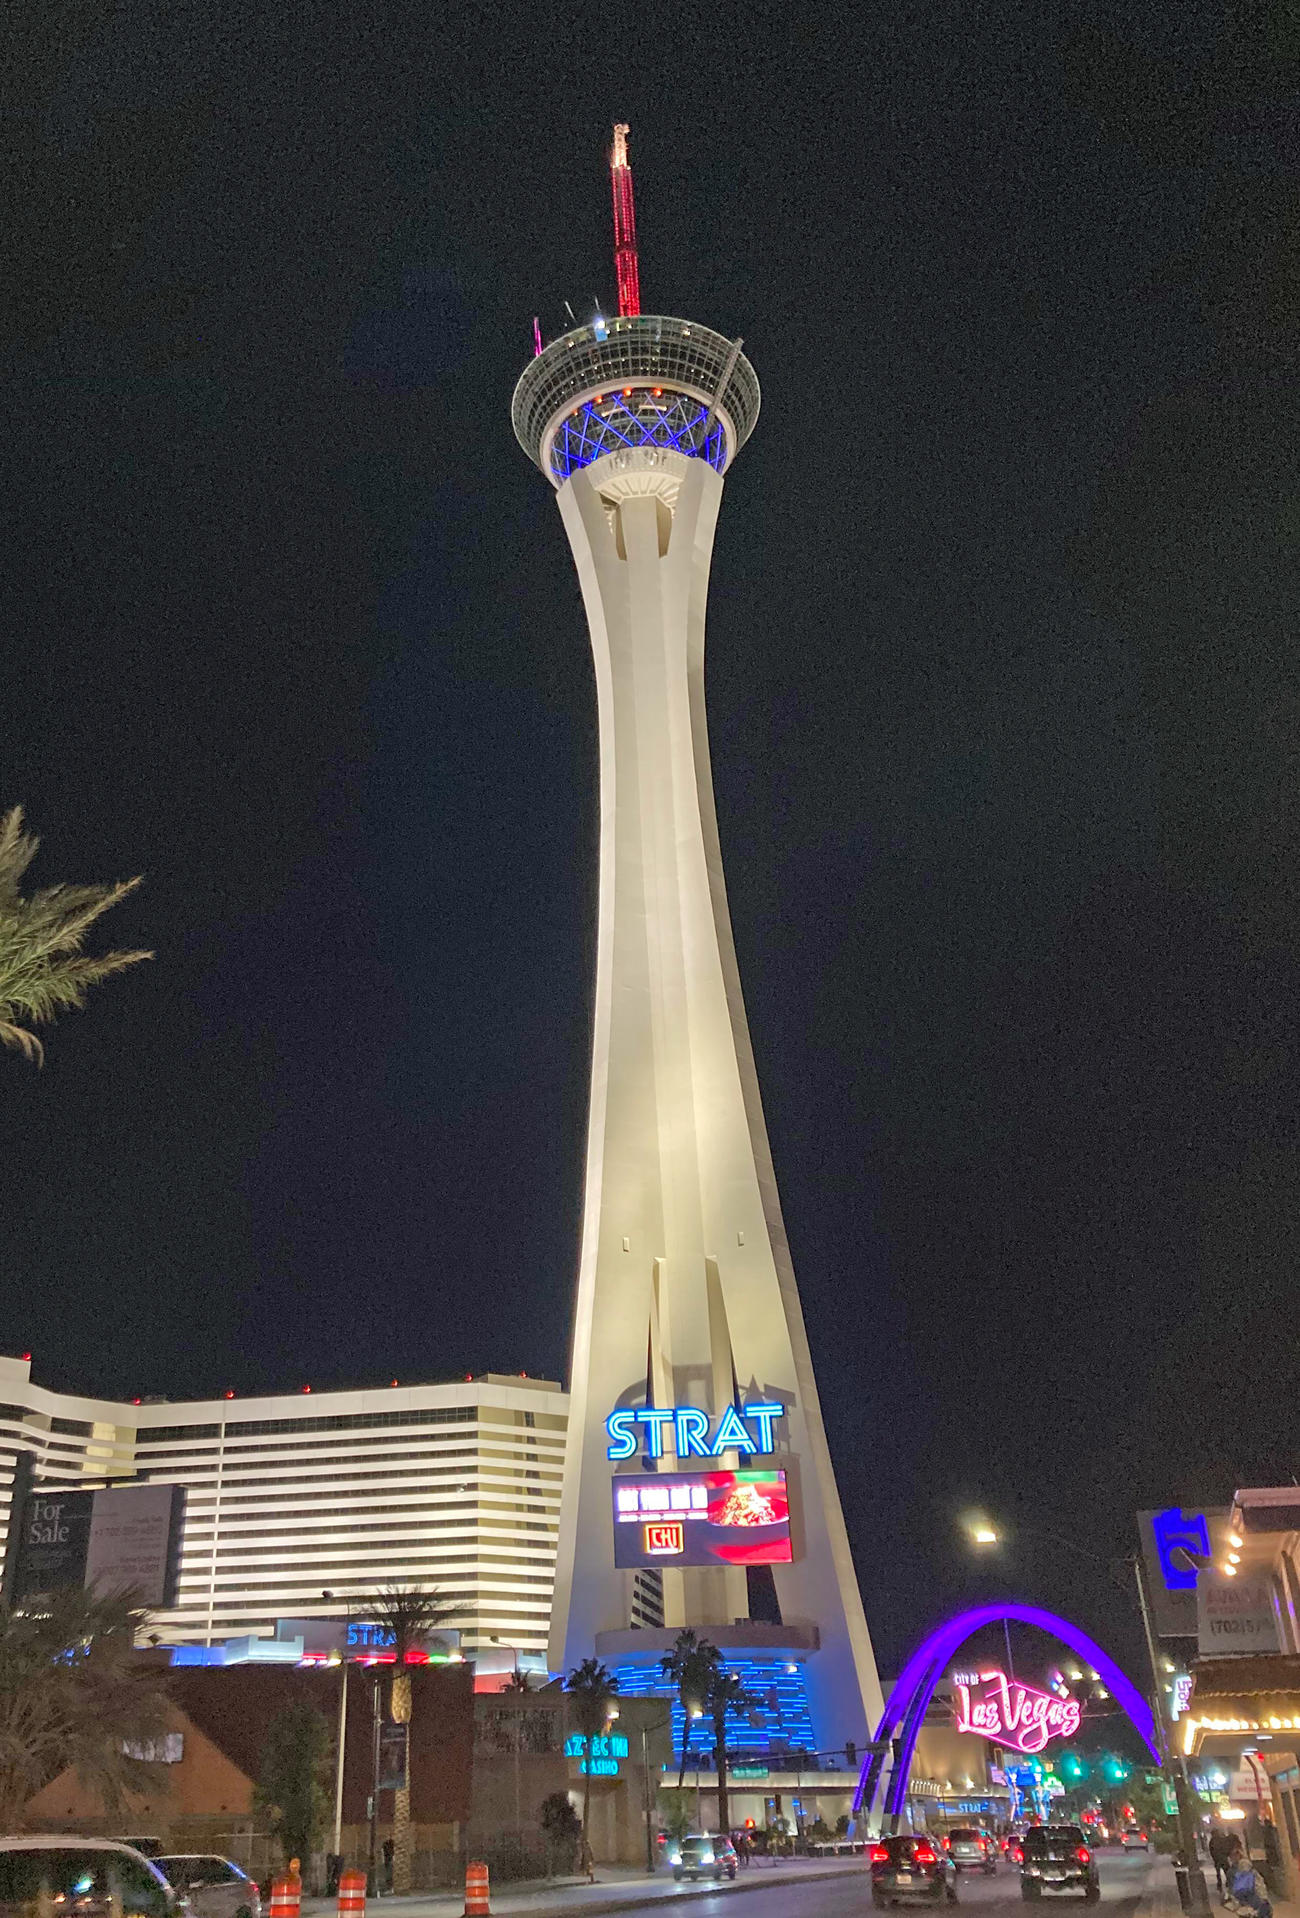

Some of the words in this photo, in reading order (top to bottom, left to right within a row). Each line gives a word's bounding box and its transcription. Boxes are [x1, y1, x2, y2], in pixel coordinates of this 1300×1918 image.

[607, 1404, 784, 1459] STRAT
[33, 1500, 65, 1521] For
[29, 1521, 69, 1544] Sale
[652, 1528, 677, 1547] CHI
[347, 1623, 398, 1646] STRA
[954, 1674, 969, 1685] CITY
[970, 1674, 979, 1685] OF
[957, 1684, 1001, 1734] Las
[980, 1671, 1081, 1753] Vegas
[580, 1758, 619, 1776] CASINO
